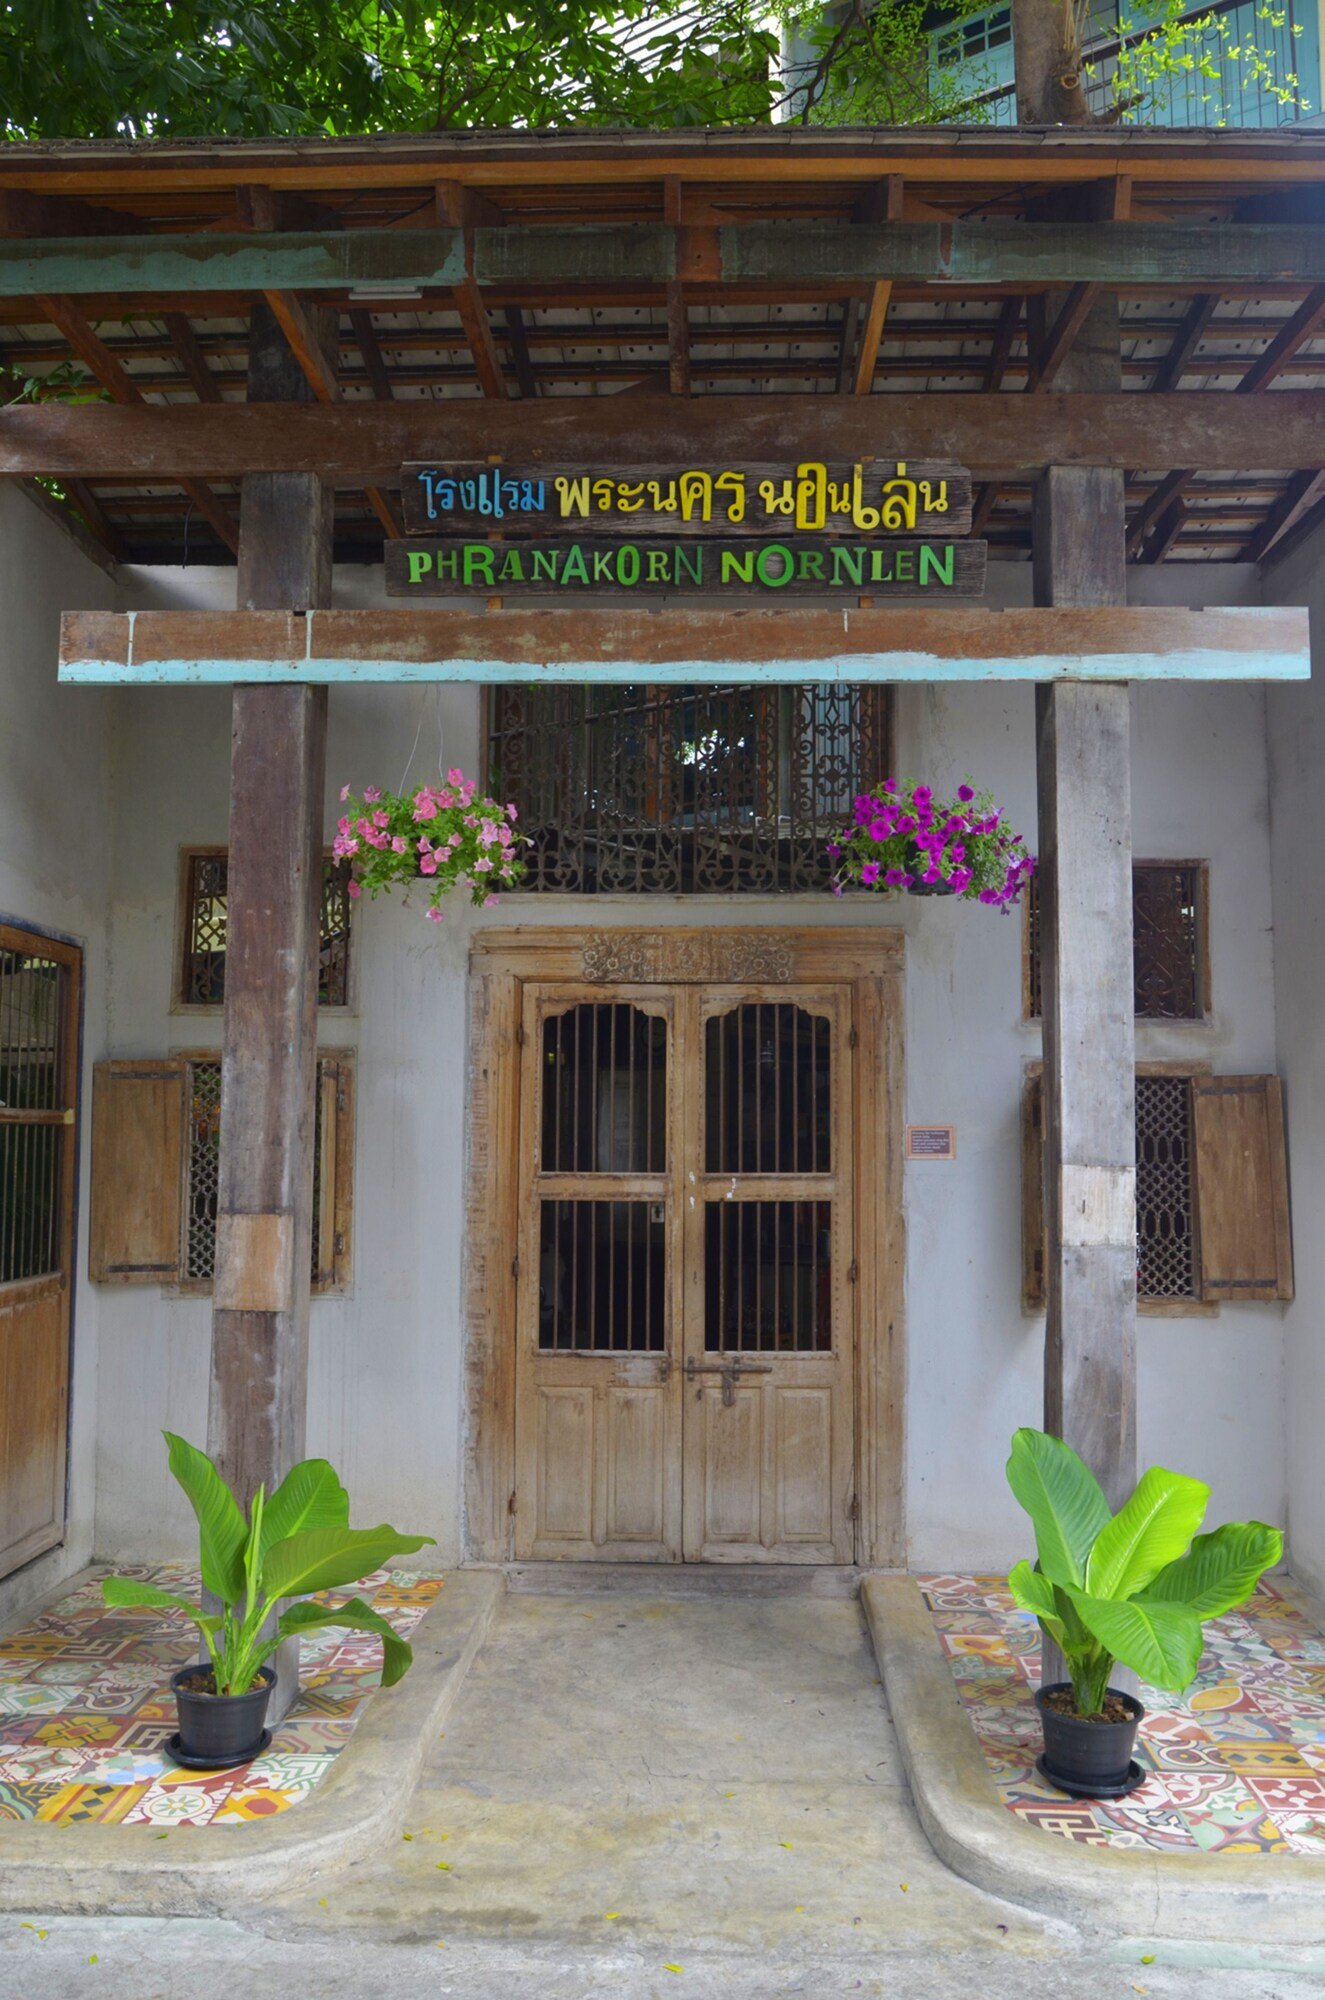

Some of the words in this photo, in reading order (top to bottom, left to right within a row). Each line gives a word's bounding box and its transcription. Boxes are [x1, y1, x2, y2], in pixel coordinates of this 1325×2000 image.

[418, 469, 544, 519] โรงแรม
[555, 471, 746, 523] พระนคร
[759, 462, 949, 530] นอนเล่น
[407, 544, 702, 586] PHRANAKORN
[721, 544, 954, 587] NORNLEN
